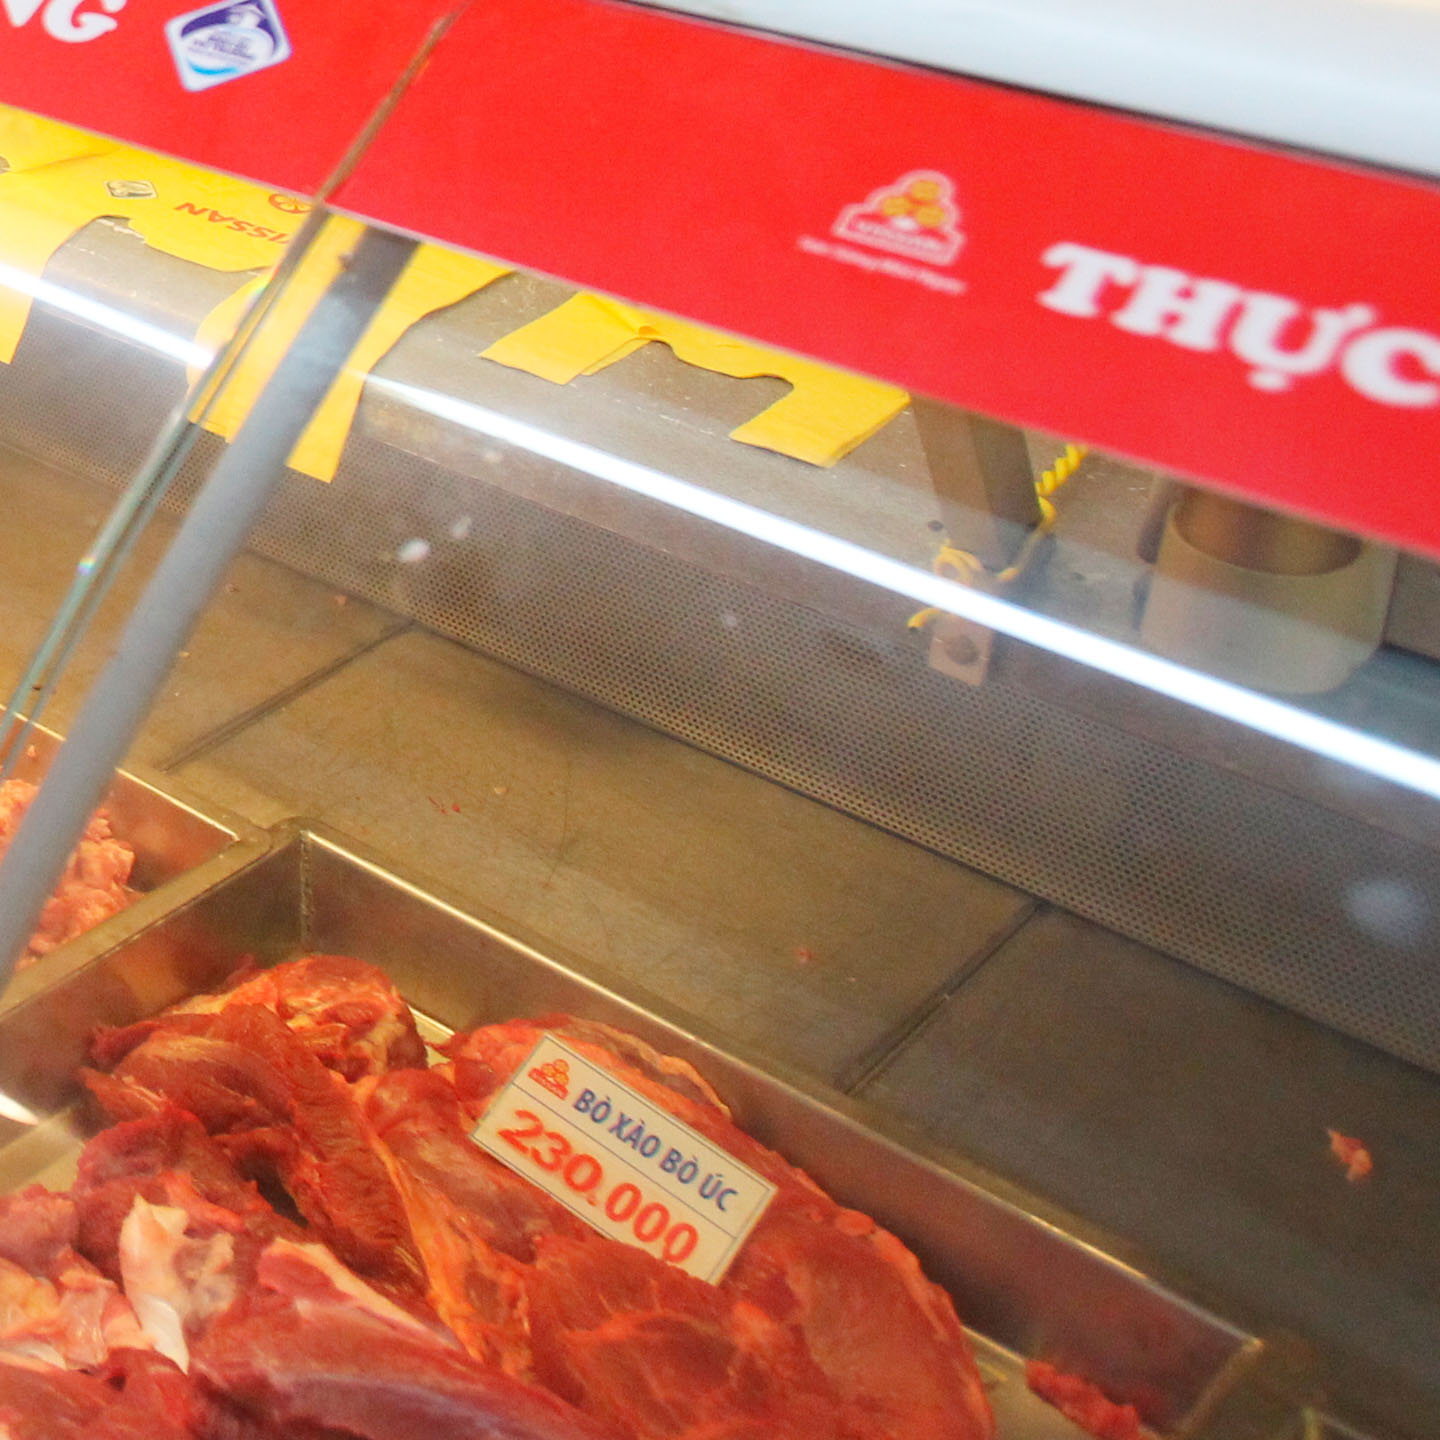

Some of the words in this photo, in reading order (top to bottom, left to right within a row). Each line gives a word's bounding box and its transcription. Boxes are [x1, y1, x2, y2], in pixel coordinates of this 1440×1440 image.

[1036, 241, 1440, 408] THỰC
[497, 1109, 699, 1265] 230.000
[573, 1088, 612, 1124] BÒ
[609, 1112, 661, 1159] XÀO
[659, 1148, 700, 1184] BÒ
[698, 1173, 739, 1212] ÚC
